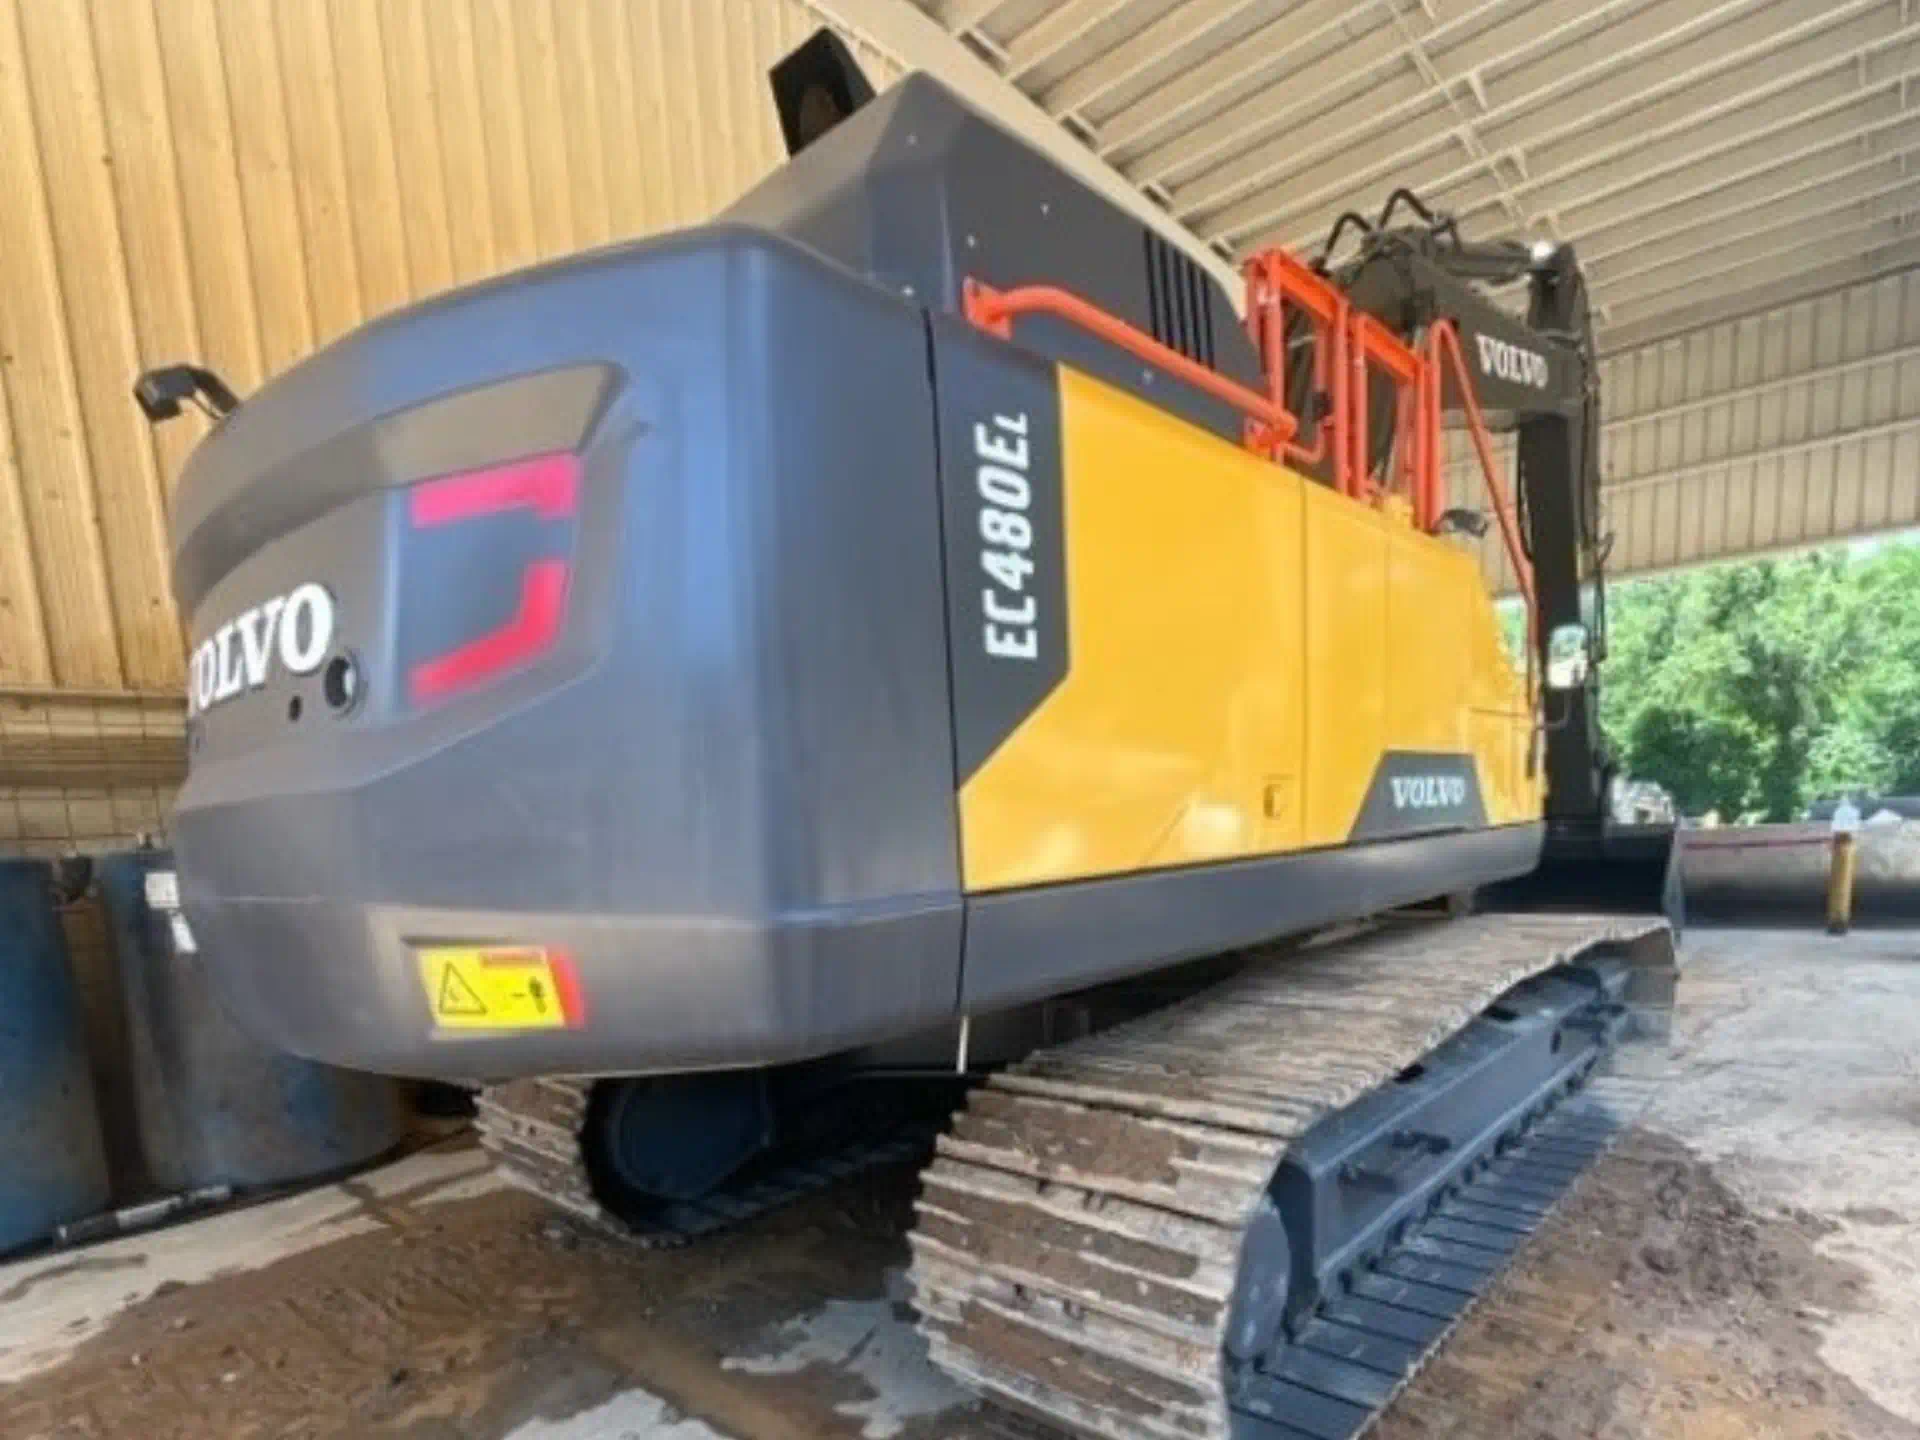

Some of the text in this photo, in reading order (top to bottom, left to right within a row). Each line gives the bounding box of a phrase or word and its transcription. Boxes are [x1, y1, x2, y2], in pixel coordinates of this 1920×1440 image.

[1475, 333, 1548, 388] VOLVO
[975, 413, 1037, 659] EC480EL
[1391, 776, 1465, 809] VOLVO
